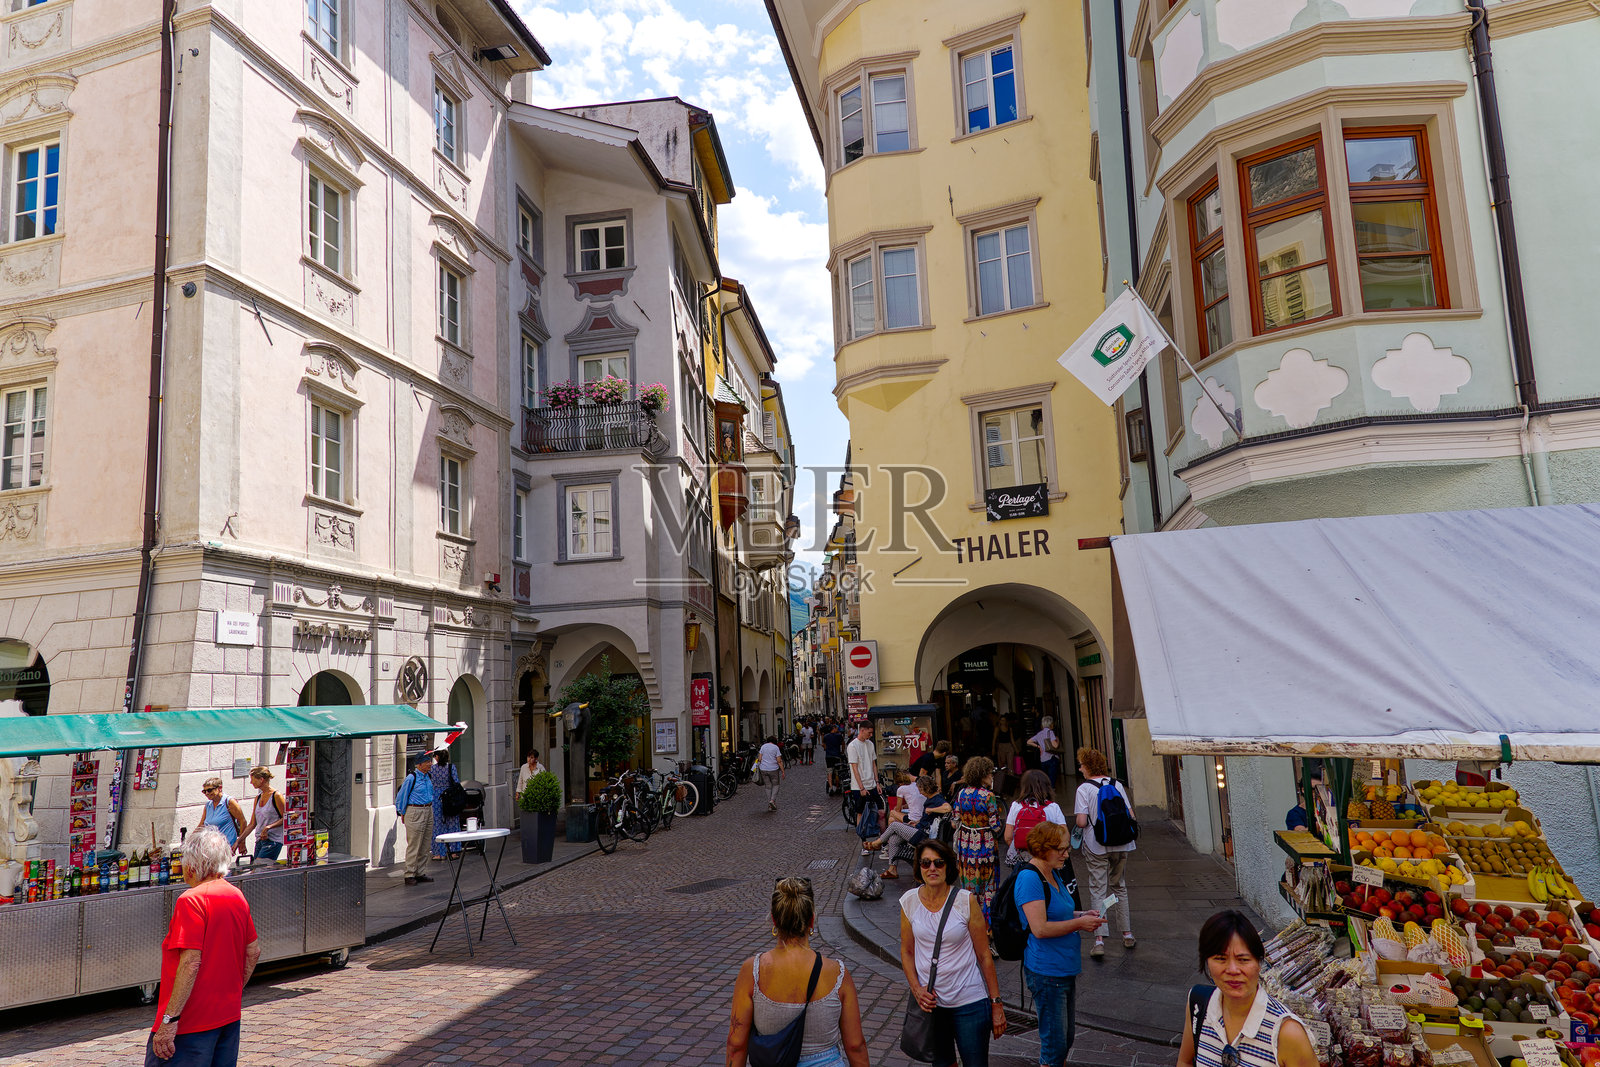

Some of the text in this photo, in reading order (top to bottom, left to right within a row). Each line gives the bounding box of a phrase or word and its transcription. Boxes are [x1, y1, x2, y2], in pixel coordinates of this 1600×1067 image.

[998, 493, 1036, 508] Perlage
[952, 529, 1050, 564] THALER
[888, 738, 920, 750] 39,90
